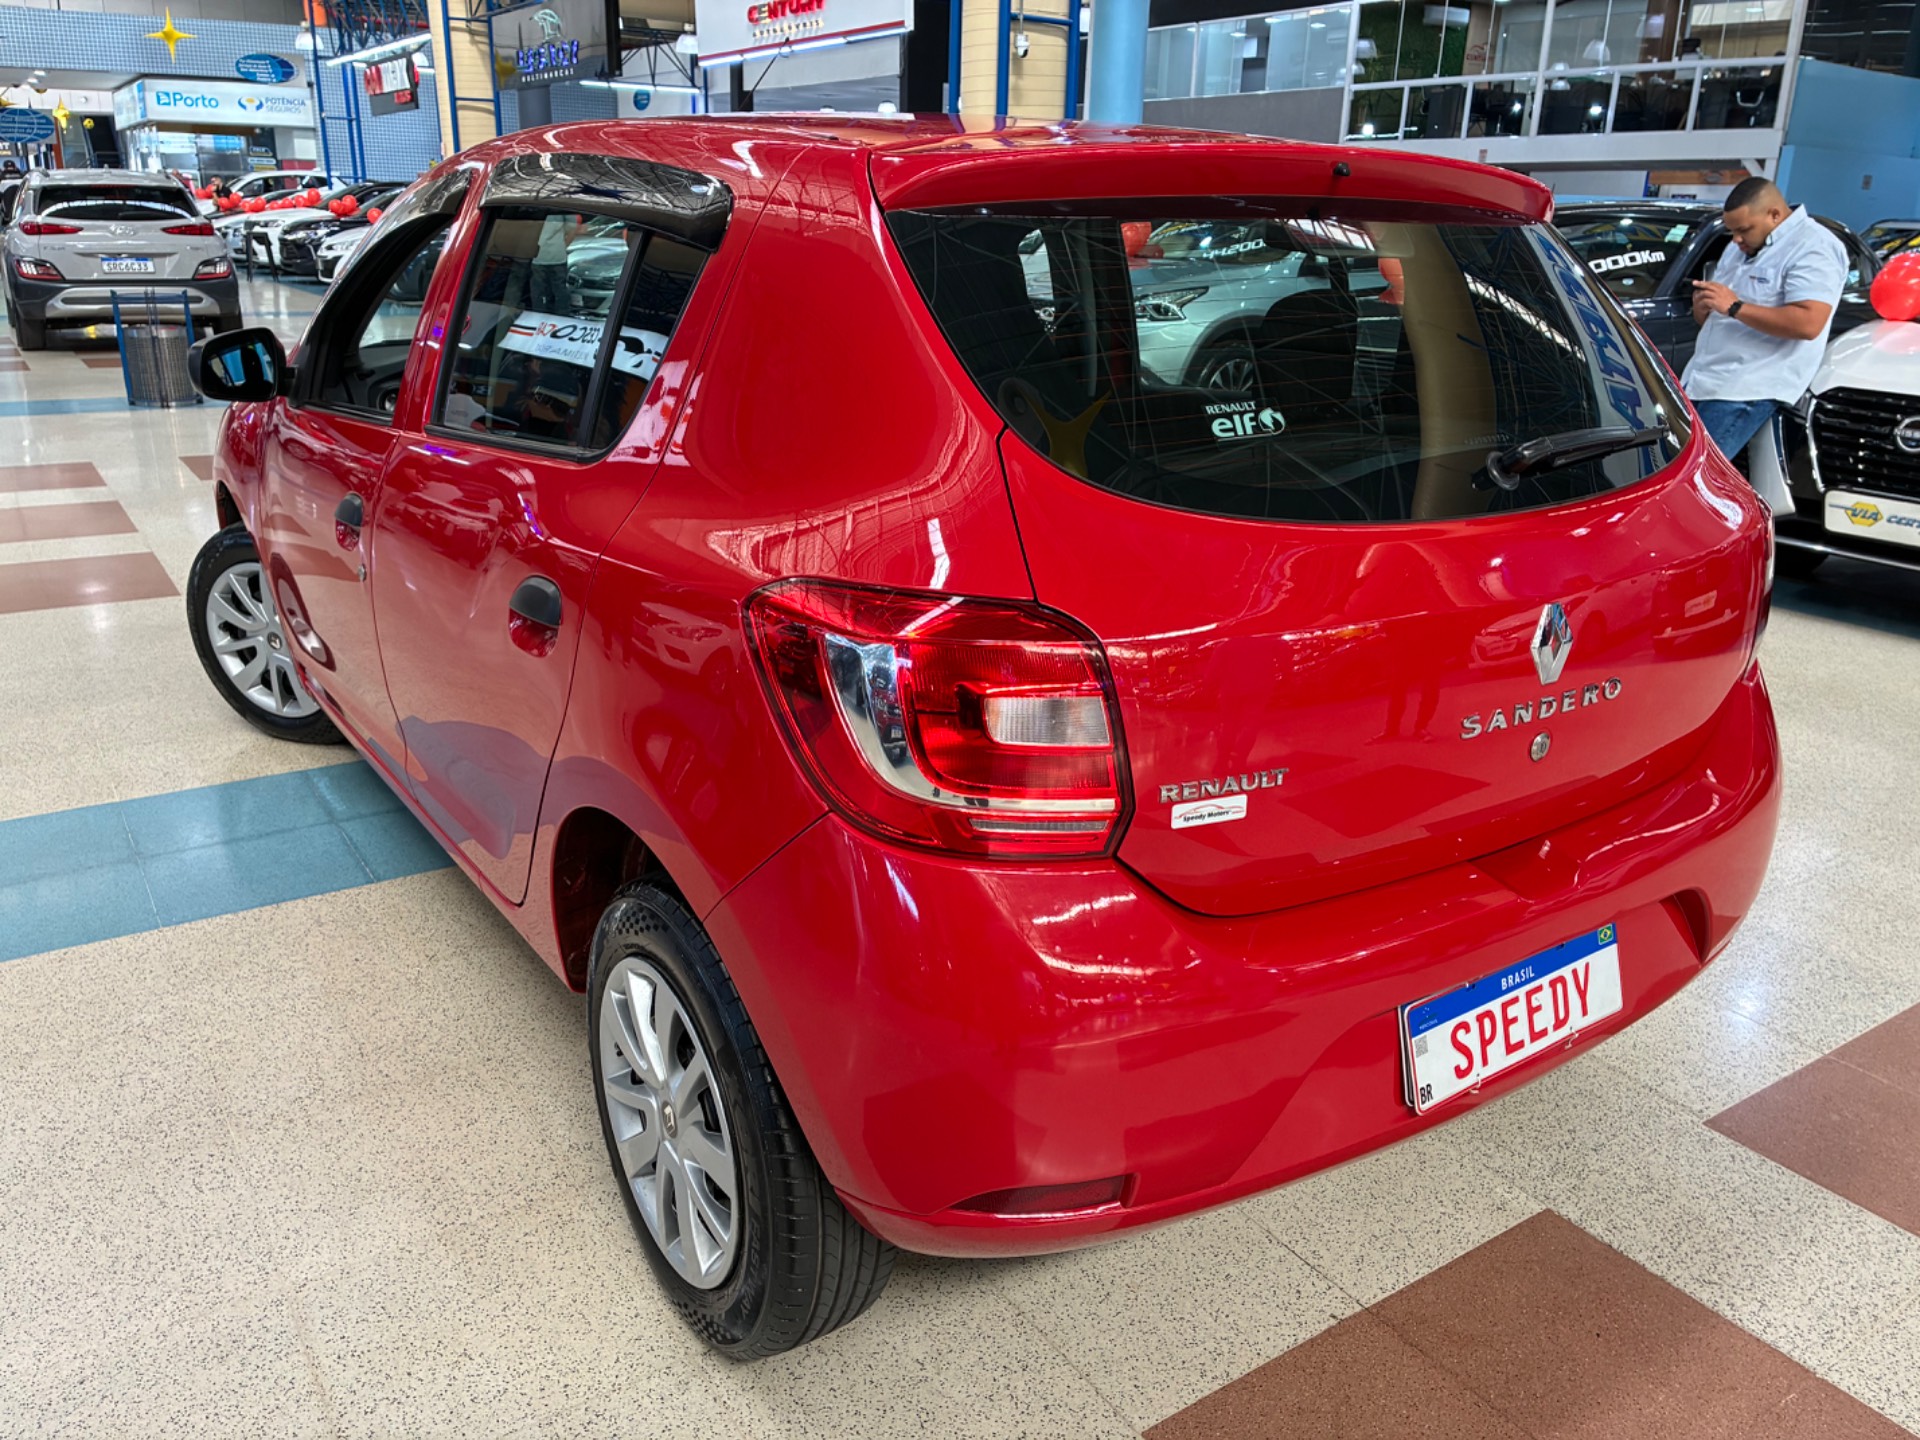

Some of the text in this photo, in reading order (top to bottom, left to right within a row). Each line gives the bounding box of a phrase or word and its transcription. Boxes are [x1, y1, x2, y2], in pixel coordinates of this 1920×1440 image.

[747, 0, 826, 25] CENTURY
[173, 92, 219, 108] Porto
[1205, 401, 1257, 415] RENAULT
[1211, 413, 1257, 437] elf
[1461, 677, 1623, 739] SANDERO
[1159, 768, 1289, 804] RENAULT
[1182, 813, 1206, 823] Speedy
[1501, 965, 1535, 990] BRASIL
[1450, 962, 1590, 1080] SPEEDY
[1419, 1083, 1433, 1105] BR
